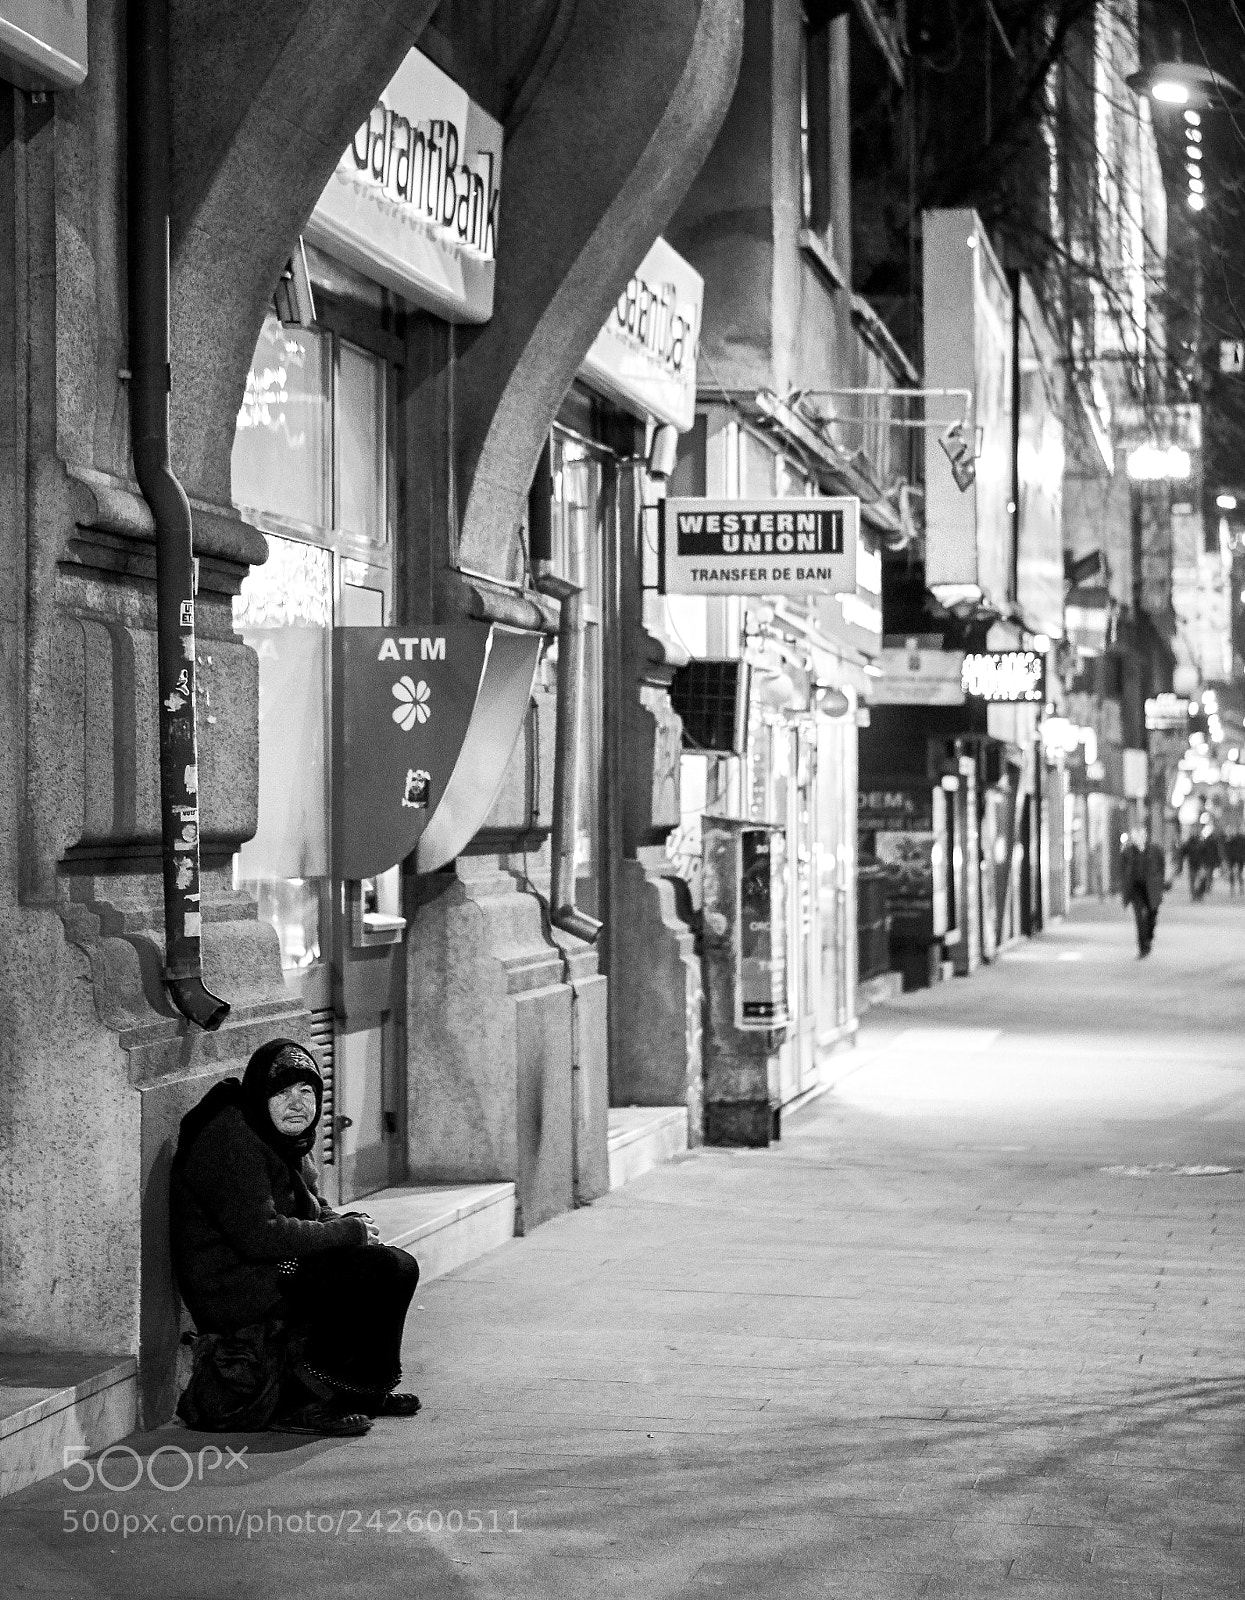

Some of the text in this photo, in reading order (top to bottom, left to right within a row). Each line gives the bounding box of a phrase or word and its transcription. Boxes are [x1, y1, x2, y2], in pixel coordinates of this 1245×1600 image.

[679, 513, 816, 534] WESTERN
[722, 533, 816, 552] UNION
[691, 567, 832, 582] TRANSFER DE BANI
[378, 637, 446, 661] ATM
